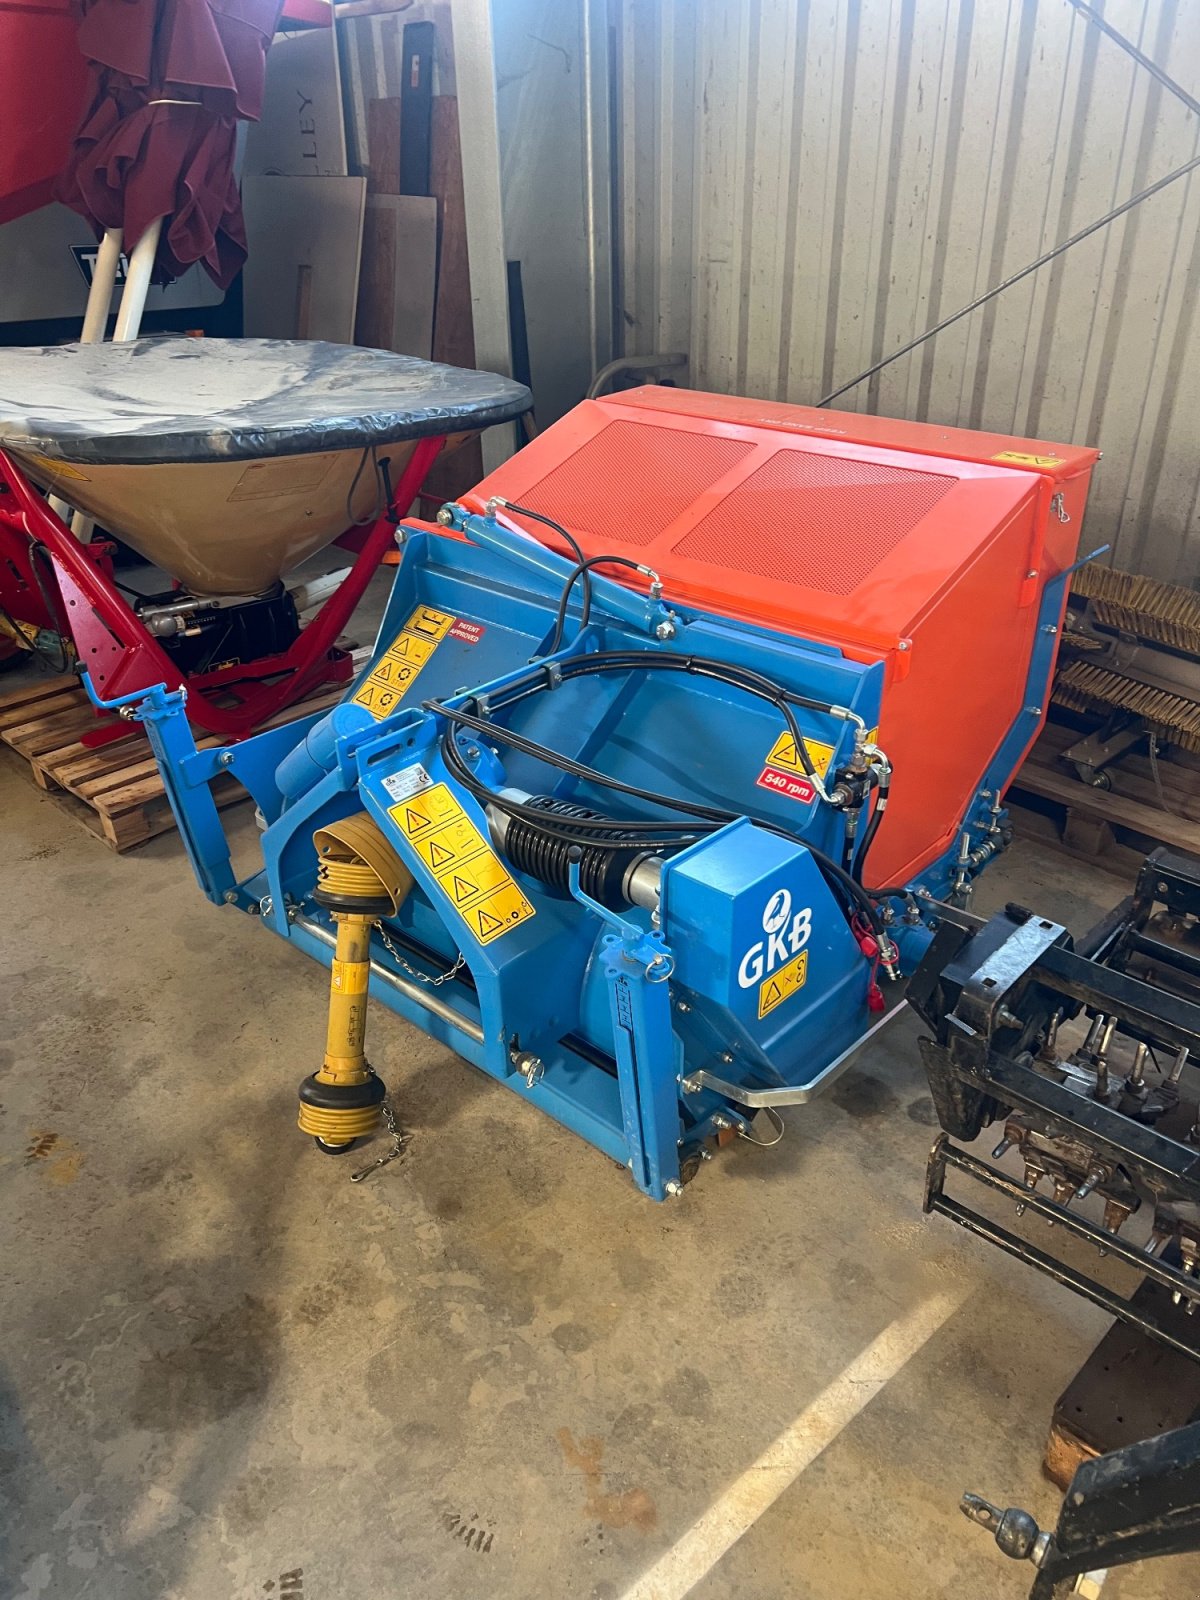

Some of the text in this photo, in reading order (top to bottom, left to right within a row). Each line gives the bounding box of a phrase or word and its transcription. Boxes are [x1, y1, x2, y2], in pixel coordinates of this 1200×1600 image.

[449, 628, 480, 642] APPROVED
[458, 622, 481, 633] PATENT
[765, 773, 810, 797] 540 rpm
[738, 907, 812, 989] GKB
